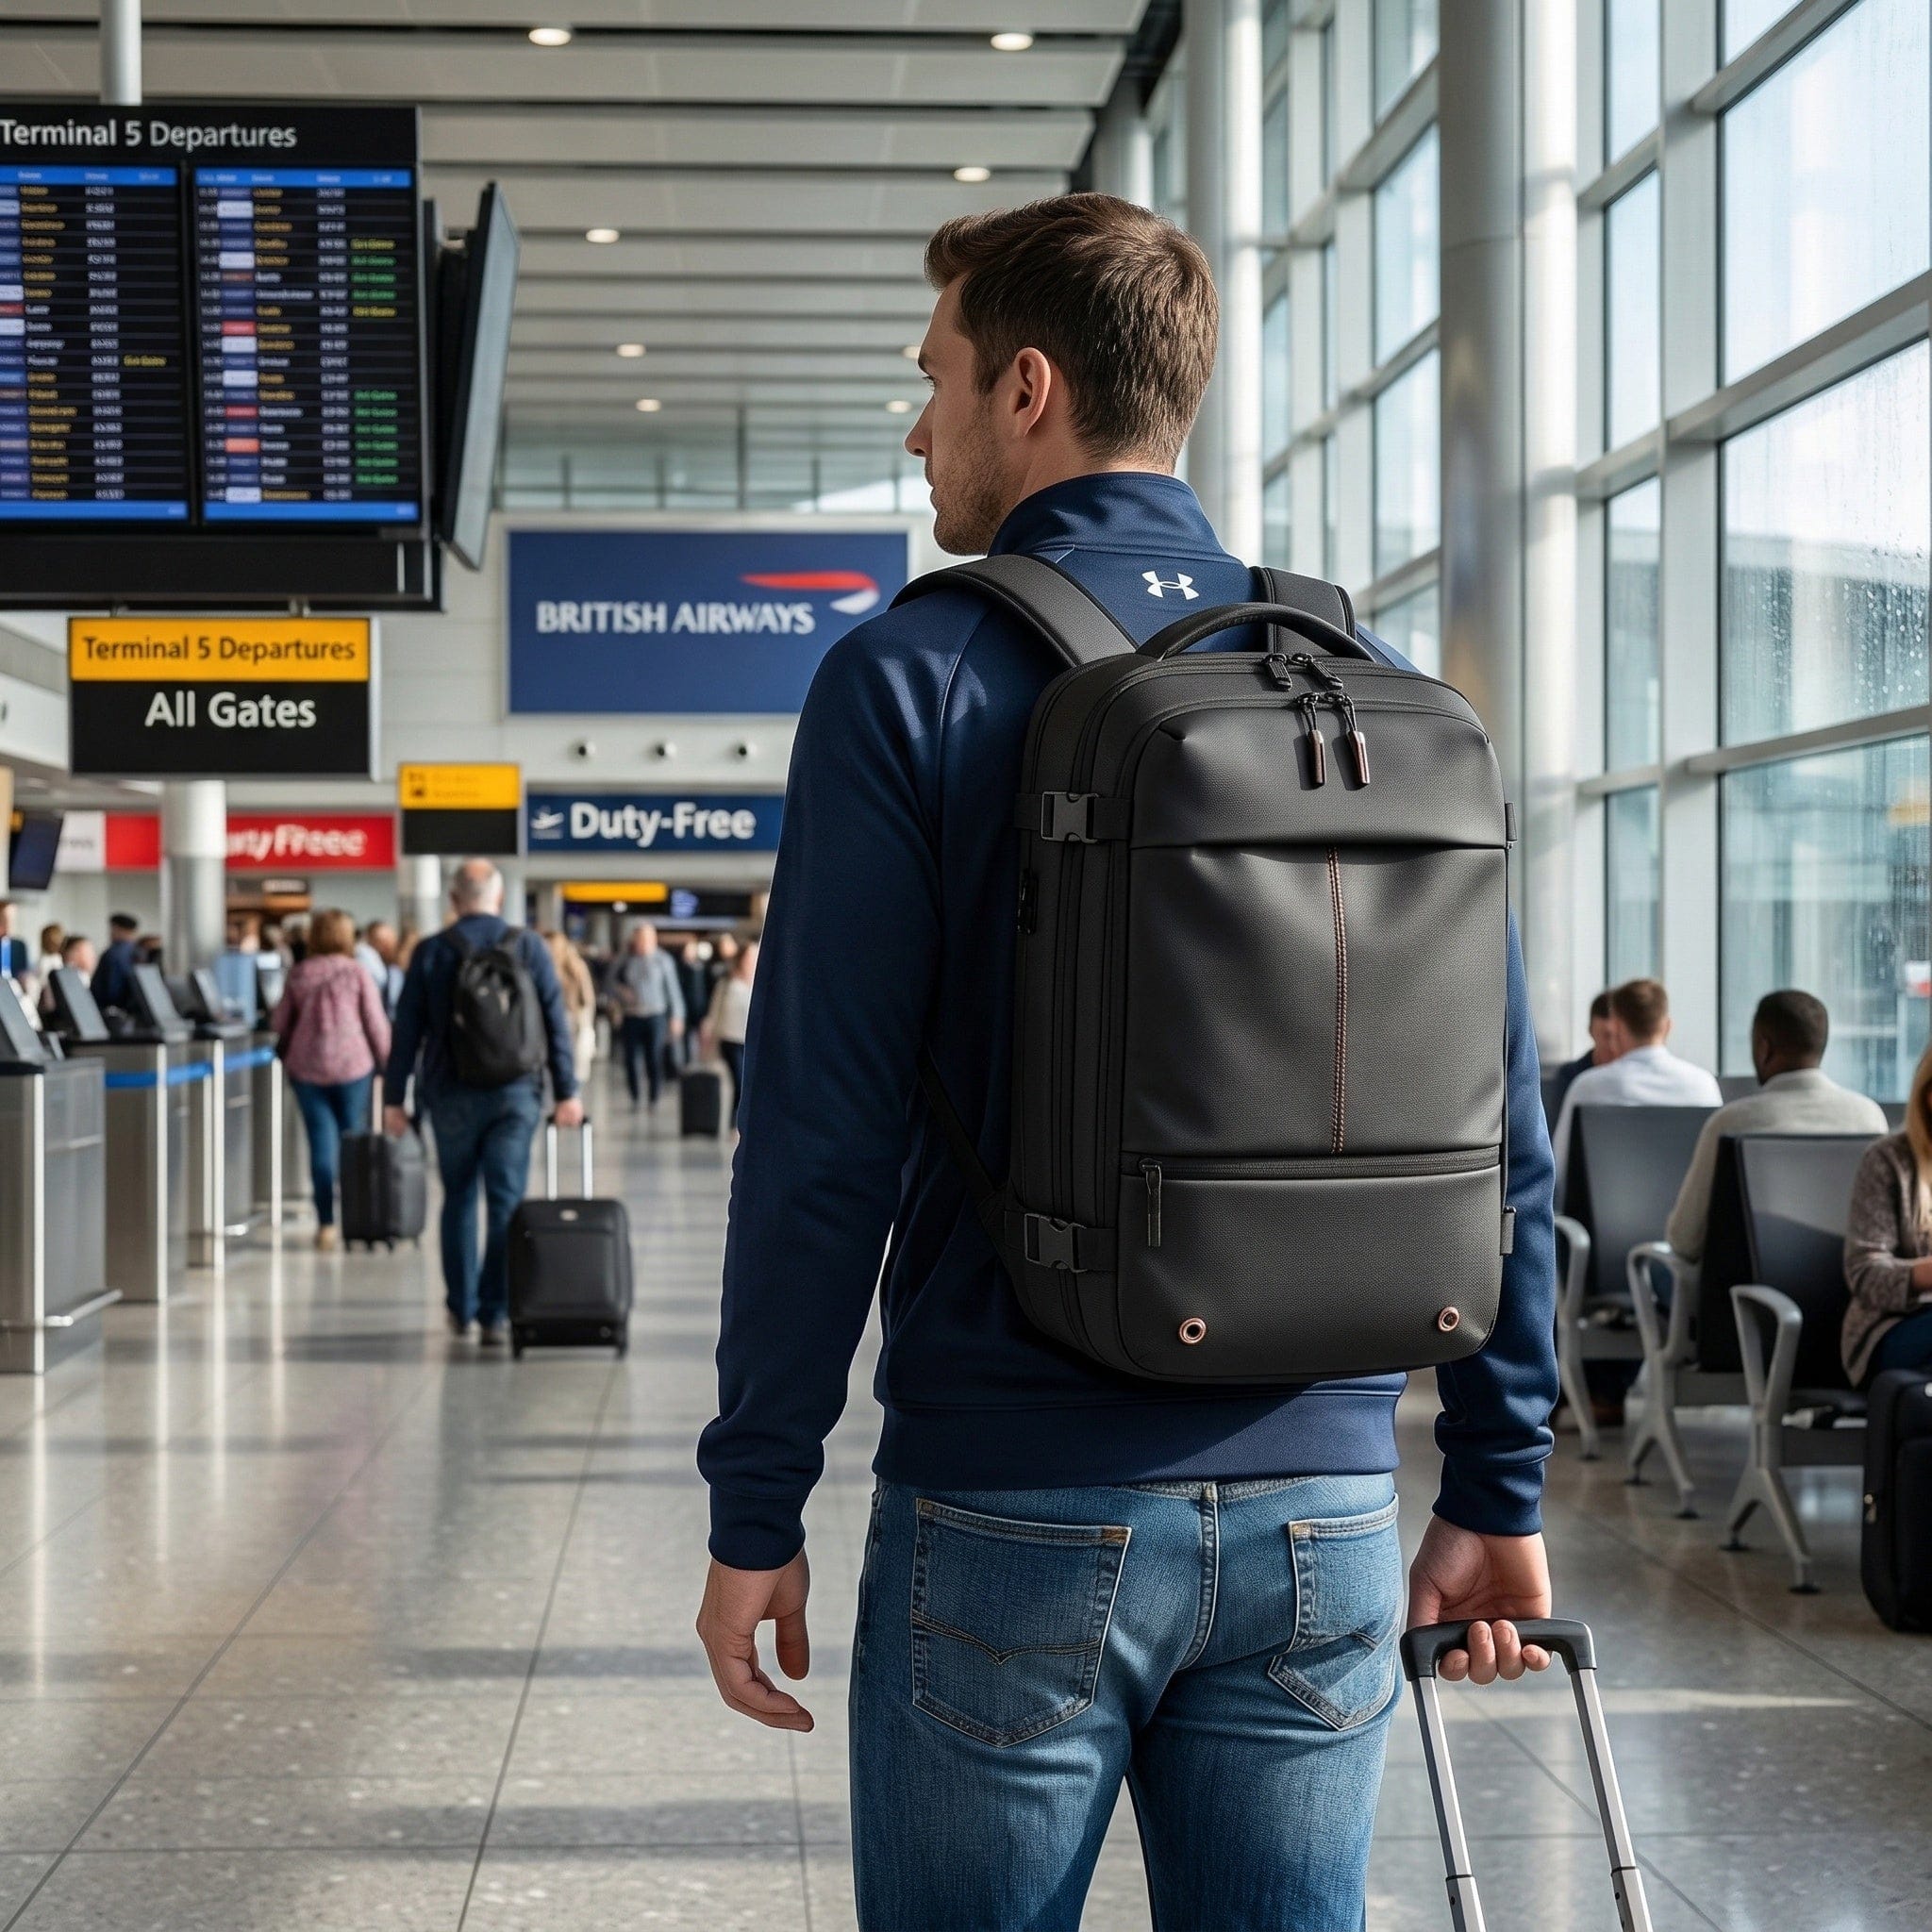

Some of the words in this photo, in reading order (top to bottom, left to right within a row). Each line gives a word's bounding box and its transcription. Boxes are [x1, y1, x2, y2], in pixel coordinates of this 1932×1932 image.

[0, 118, 116, 146] Terminal
[125, 121, 142, 146] 5
[149, 120, 298, 152] Departures
[536, 600, 666, 634] BRITISH
[671, 601, 816, 635] AIRWAYS
[83, 637, 188, 659] Terminal
[198, 637, 211, 659] 5
[219, 637, 357, 665] Departures
[144, 691, 195, 727] All
[208, 691, 316, 728] Gates
[570, 802, 757, 848] Duty-Free
